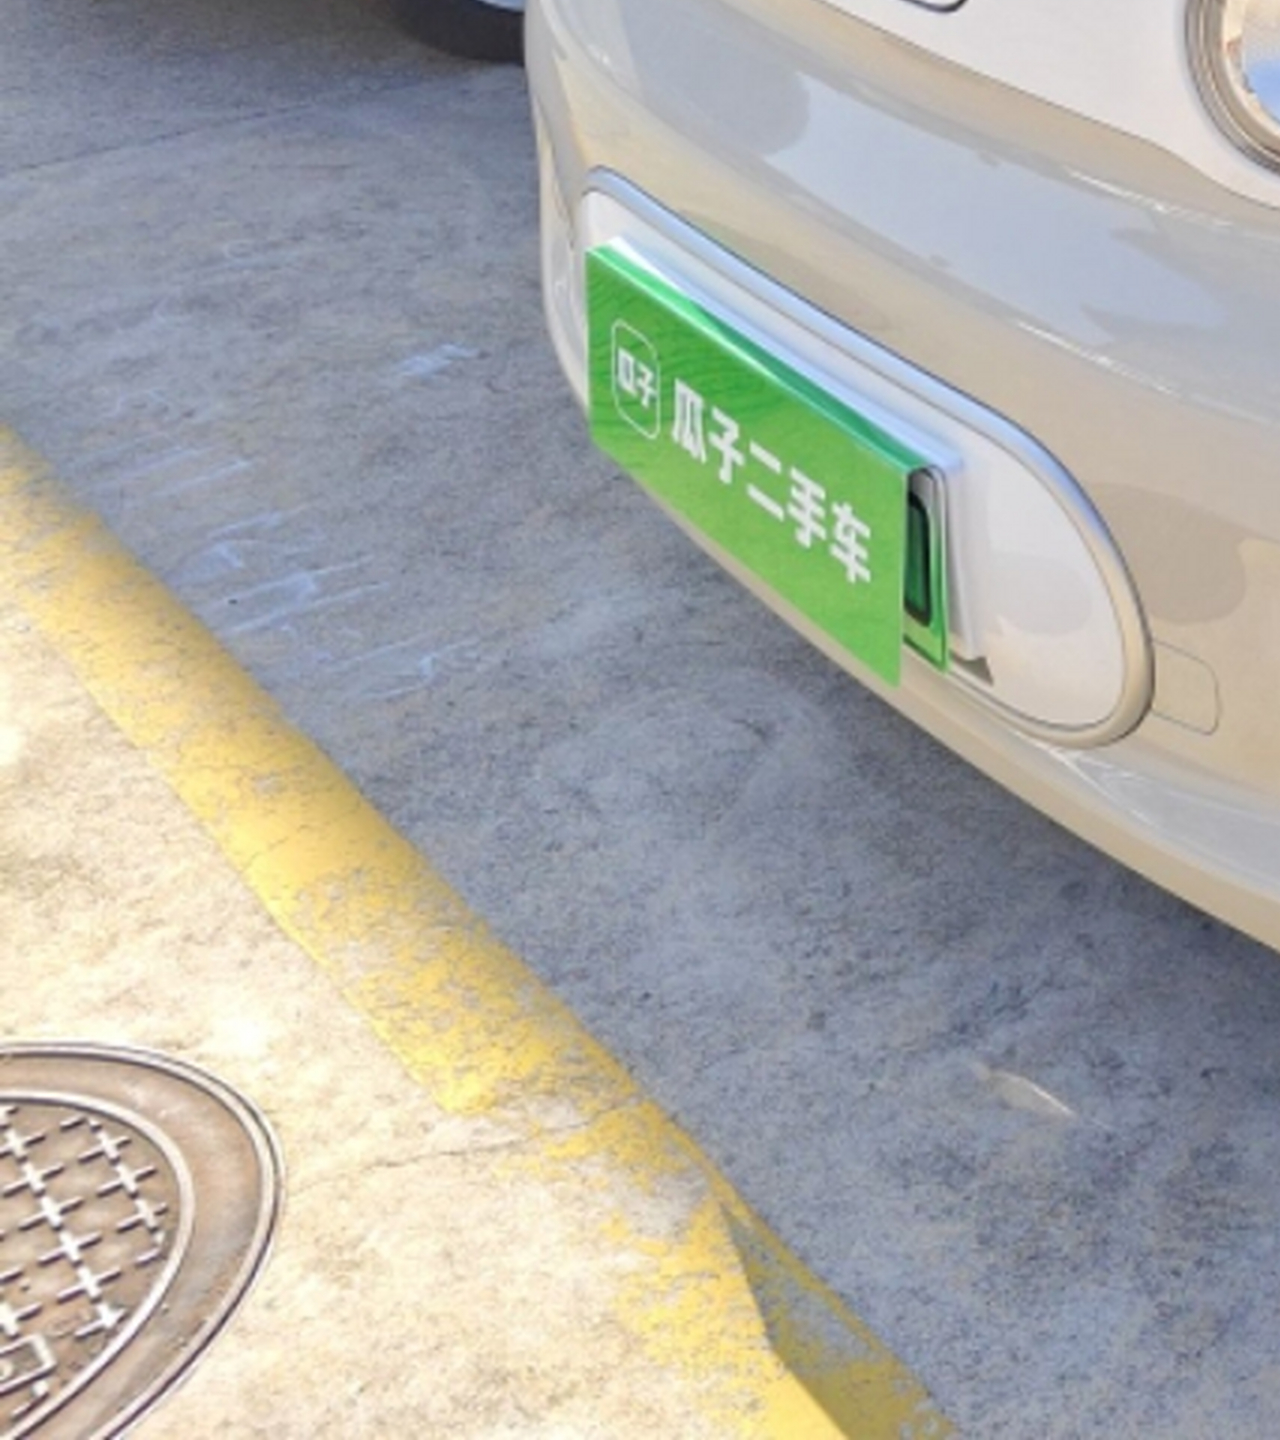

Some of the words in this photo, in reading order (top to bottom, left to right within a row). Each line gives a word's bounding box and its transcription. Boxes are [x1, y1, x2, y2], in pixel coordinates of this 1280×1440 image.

[671, 376, 872, 585] 瓜子二手车
